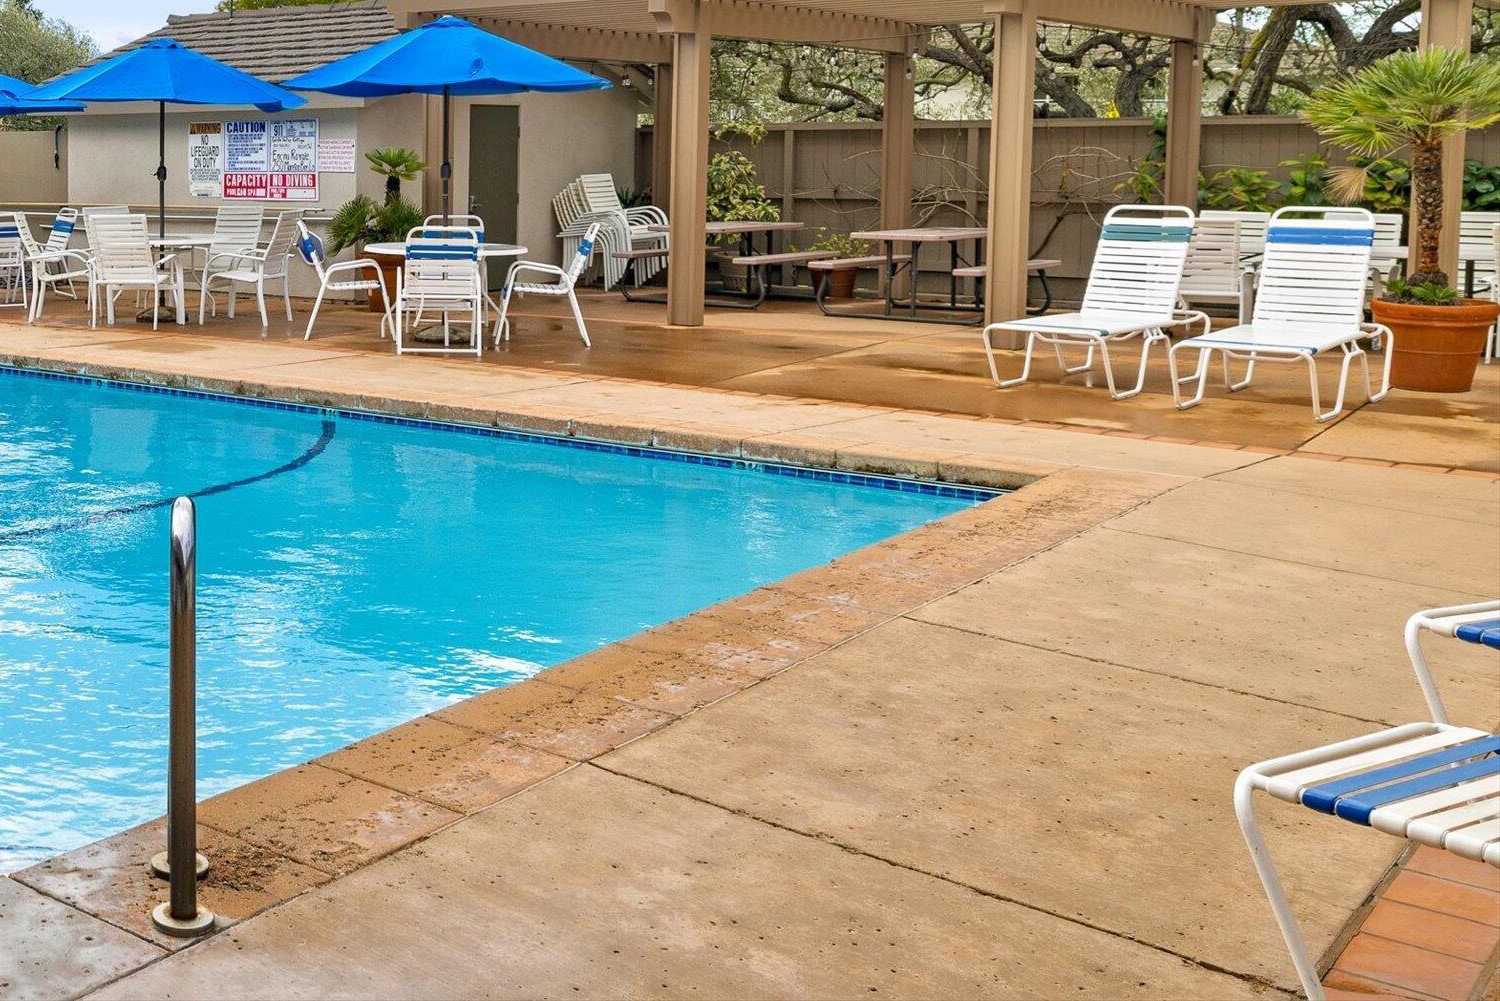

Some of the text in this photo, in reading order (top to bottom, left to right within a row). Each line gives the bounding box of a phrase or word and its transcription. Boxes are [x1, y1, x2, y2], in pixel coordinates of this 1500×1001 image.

[196, 123, 221, 134] WARNING
[226, 121, 266, 133] CAUTION
[201, 135, 209, 145] NO
[190, 146, 220, 157] LIFEGUARD
[193, 157, 217, 168] ON DUTY
[226, 174, 267, 187] CAPACITY
[272, 174, 313, 187] NO DIVING
